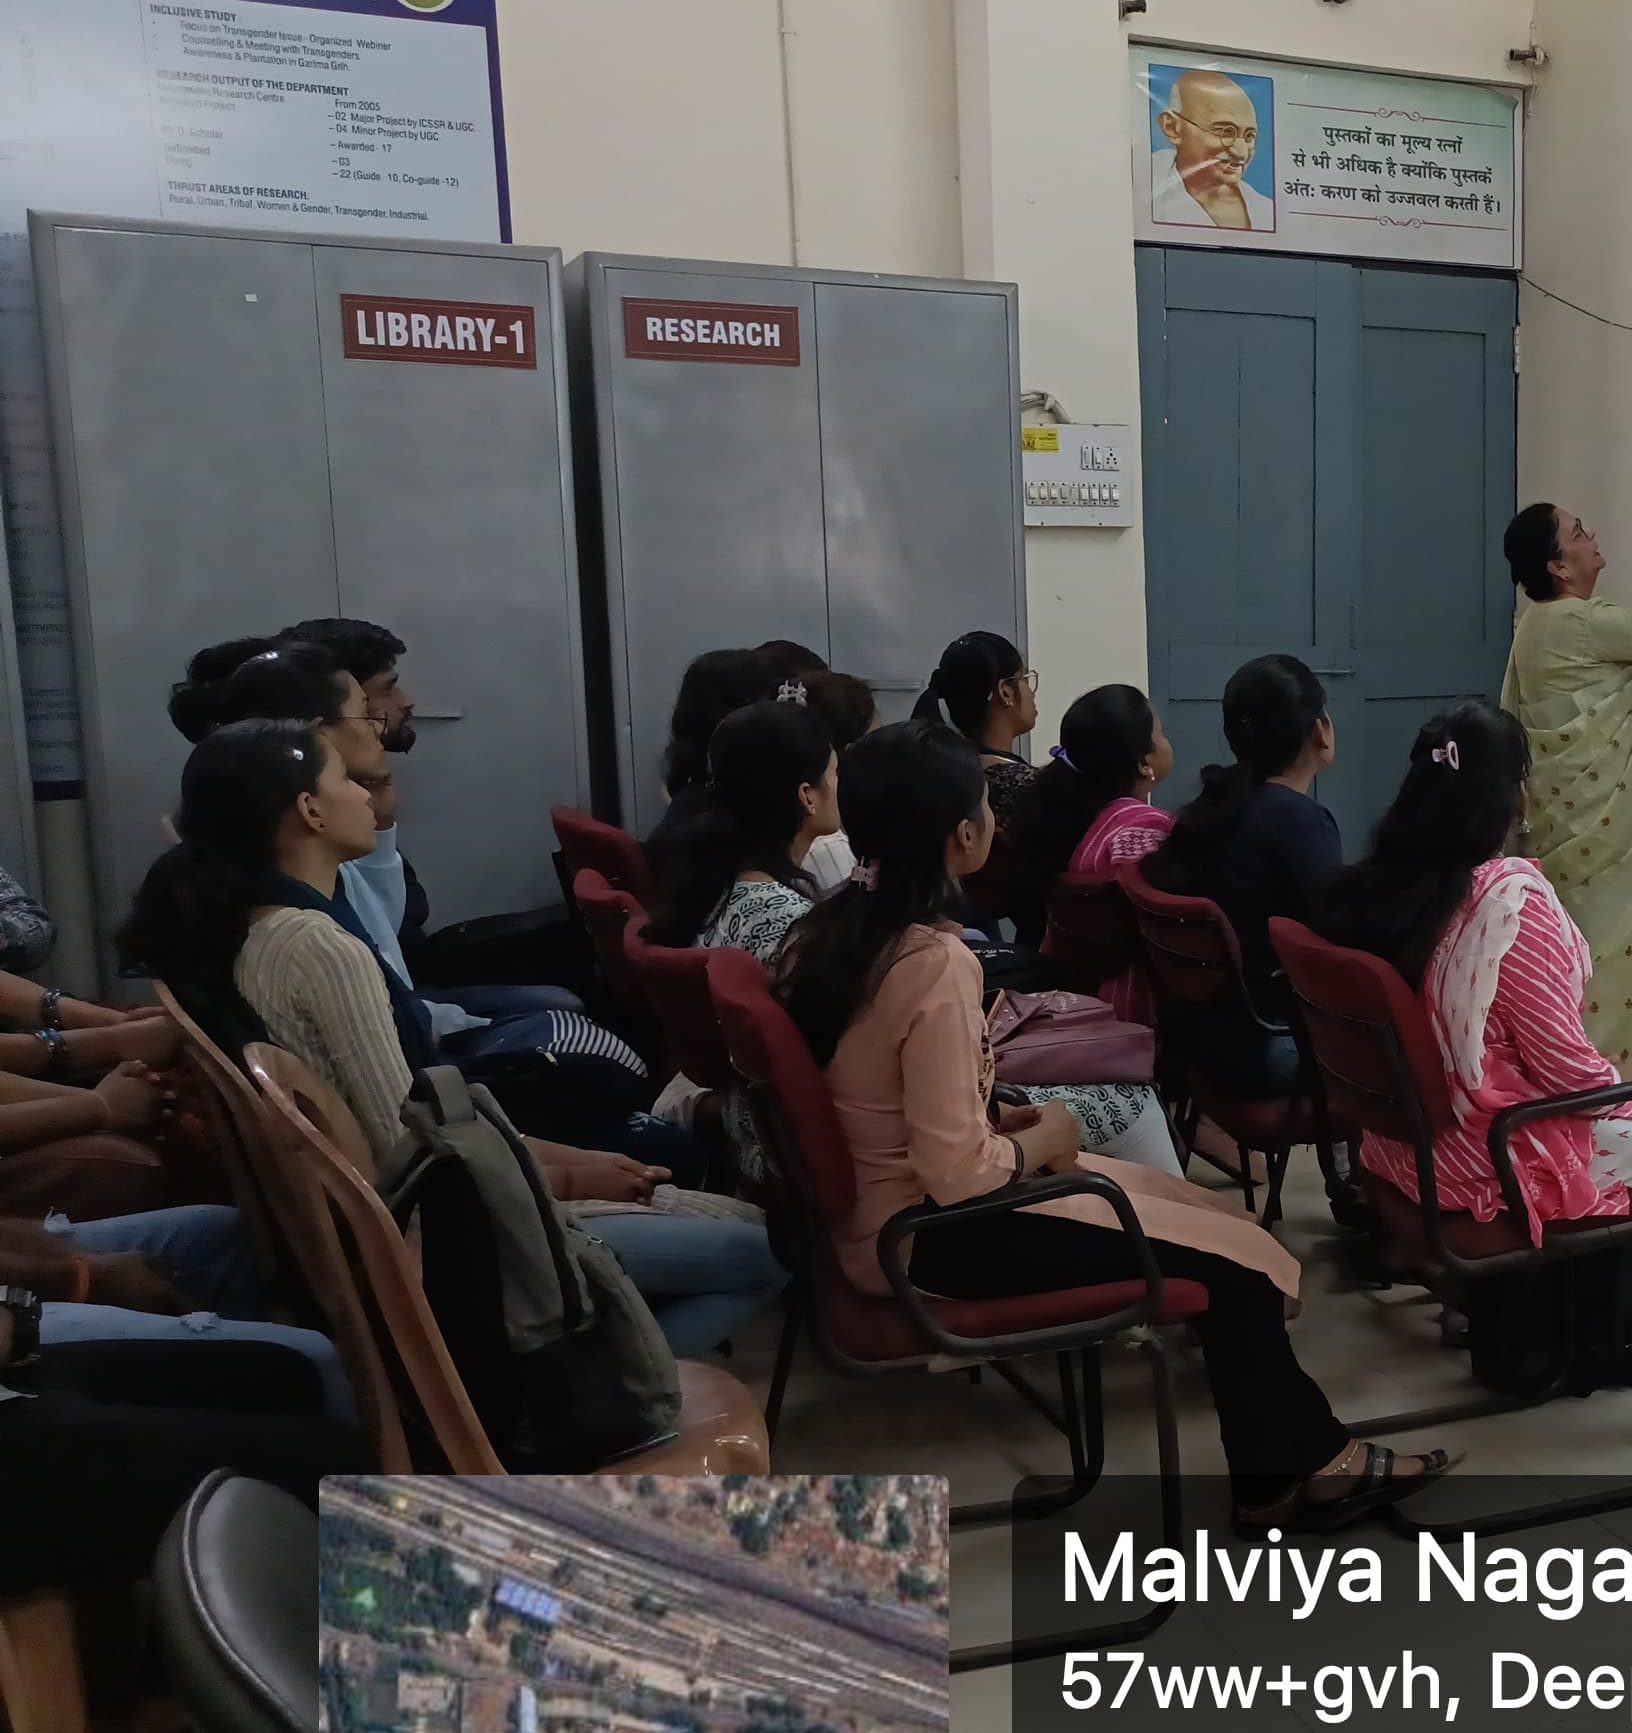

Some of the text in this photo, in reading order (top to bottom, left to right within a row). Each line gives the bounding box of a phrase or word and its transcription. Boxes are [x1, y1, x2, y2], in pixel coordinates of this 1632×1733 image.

[150, 3, 237, 22] INCLUSIVE STUDY
[181, 20, 208, 32] Focus
[209, 24, 221, 33] on
[222, 25, 277, 40] Transgender
[309, 33, 353, 49] Organized
[181, 33, 235, 50] Counselling
[245, 40, 281, 54] Meeting
[282, 43, 301, 54] with
[243, 52, 288, 66] Plantation
[298, 57, 330, 70] Garima
[211, 73, 250, 88] OUTPUT
[252, 79, 264, 88] OF
[266, 80, 285, 91] THE
[286, 81, 349, 97] DEPARTMENT
[335, 99, 357, 110] From
[358, 101, 381, 112] 2005
[351, 114, 375, 125] Major
[376, 115, 406, 127] Project
[407, 118, 418, 129] by
[352, 126, 376, 136] Minor
[377, 128, 408, 140] Project
[408, 131, 419, 142] by
[420, 132, 439, 142] UGC
[1321, 125, 1463, 154] पुस्तकों का मूल्य रत्नों
[1291, 148, 1493, 188] से भी अधिक है क्योंकि पुस्तकें
[168, 181, 207, 193] THRUST
[209, 185, 241, 196] AREAS
[242, 187, 254, 196] OF
[1319, 184, 1358, 200] करण
[1359, 183, 1381, 203] को
[1385, 190, 1440, 209] उज्जवल
[1443, 193, 1480, 212] करती
[257, 200, 291, 212] Women
[292, 203, 299, 212] &
[356, 309, 526, 354] LIBRARY-1
[646, 317, 781, 348] RESEARCH
